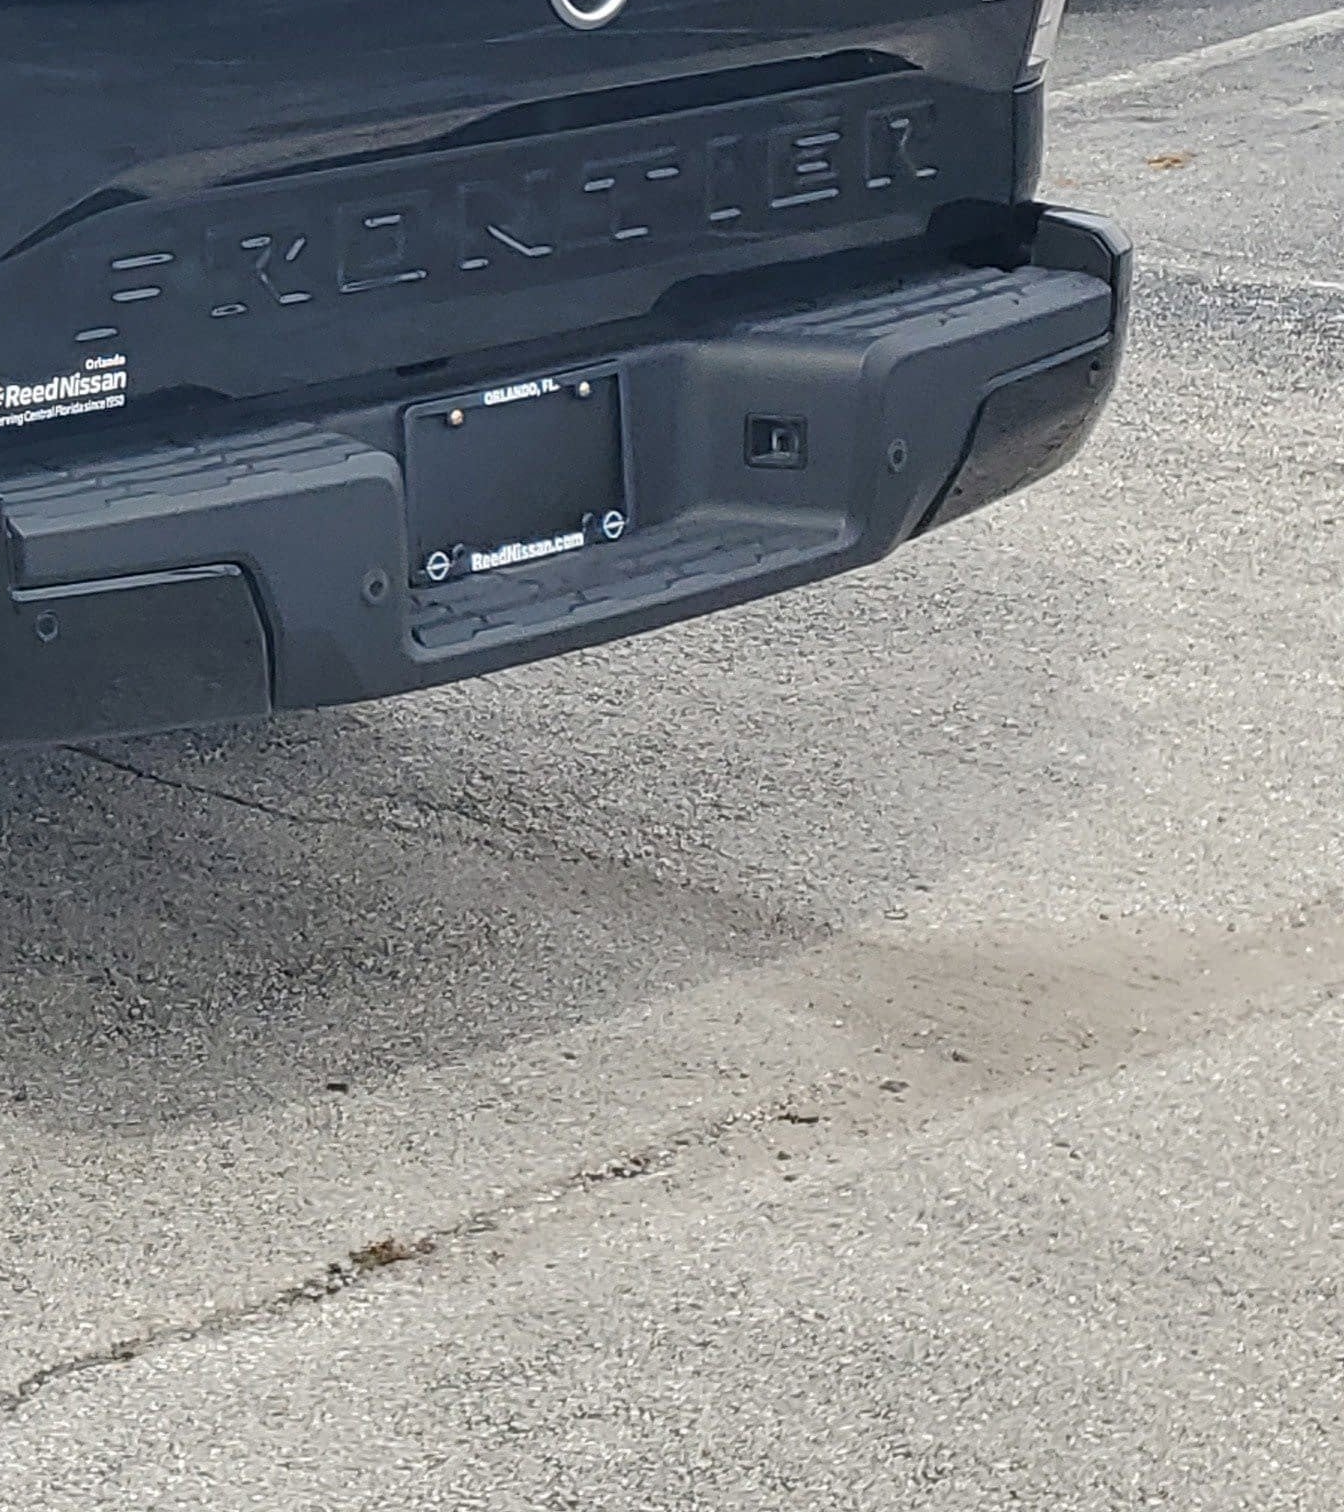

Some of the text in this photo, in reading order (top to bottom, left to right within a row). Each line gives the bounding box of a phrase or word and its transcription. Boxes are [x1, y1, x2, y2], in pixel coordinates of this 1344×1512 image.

[74, 100, 936, 341] FRONTIER
[85, 353, 126, 370] Orlando
[23, 405, 55, 422] Central
[471, 532, 584, 572] ReedNissan.com
